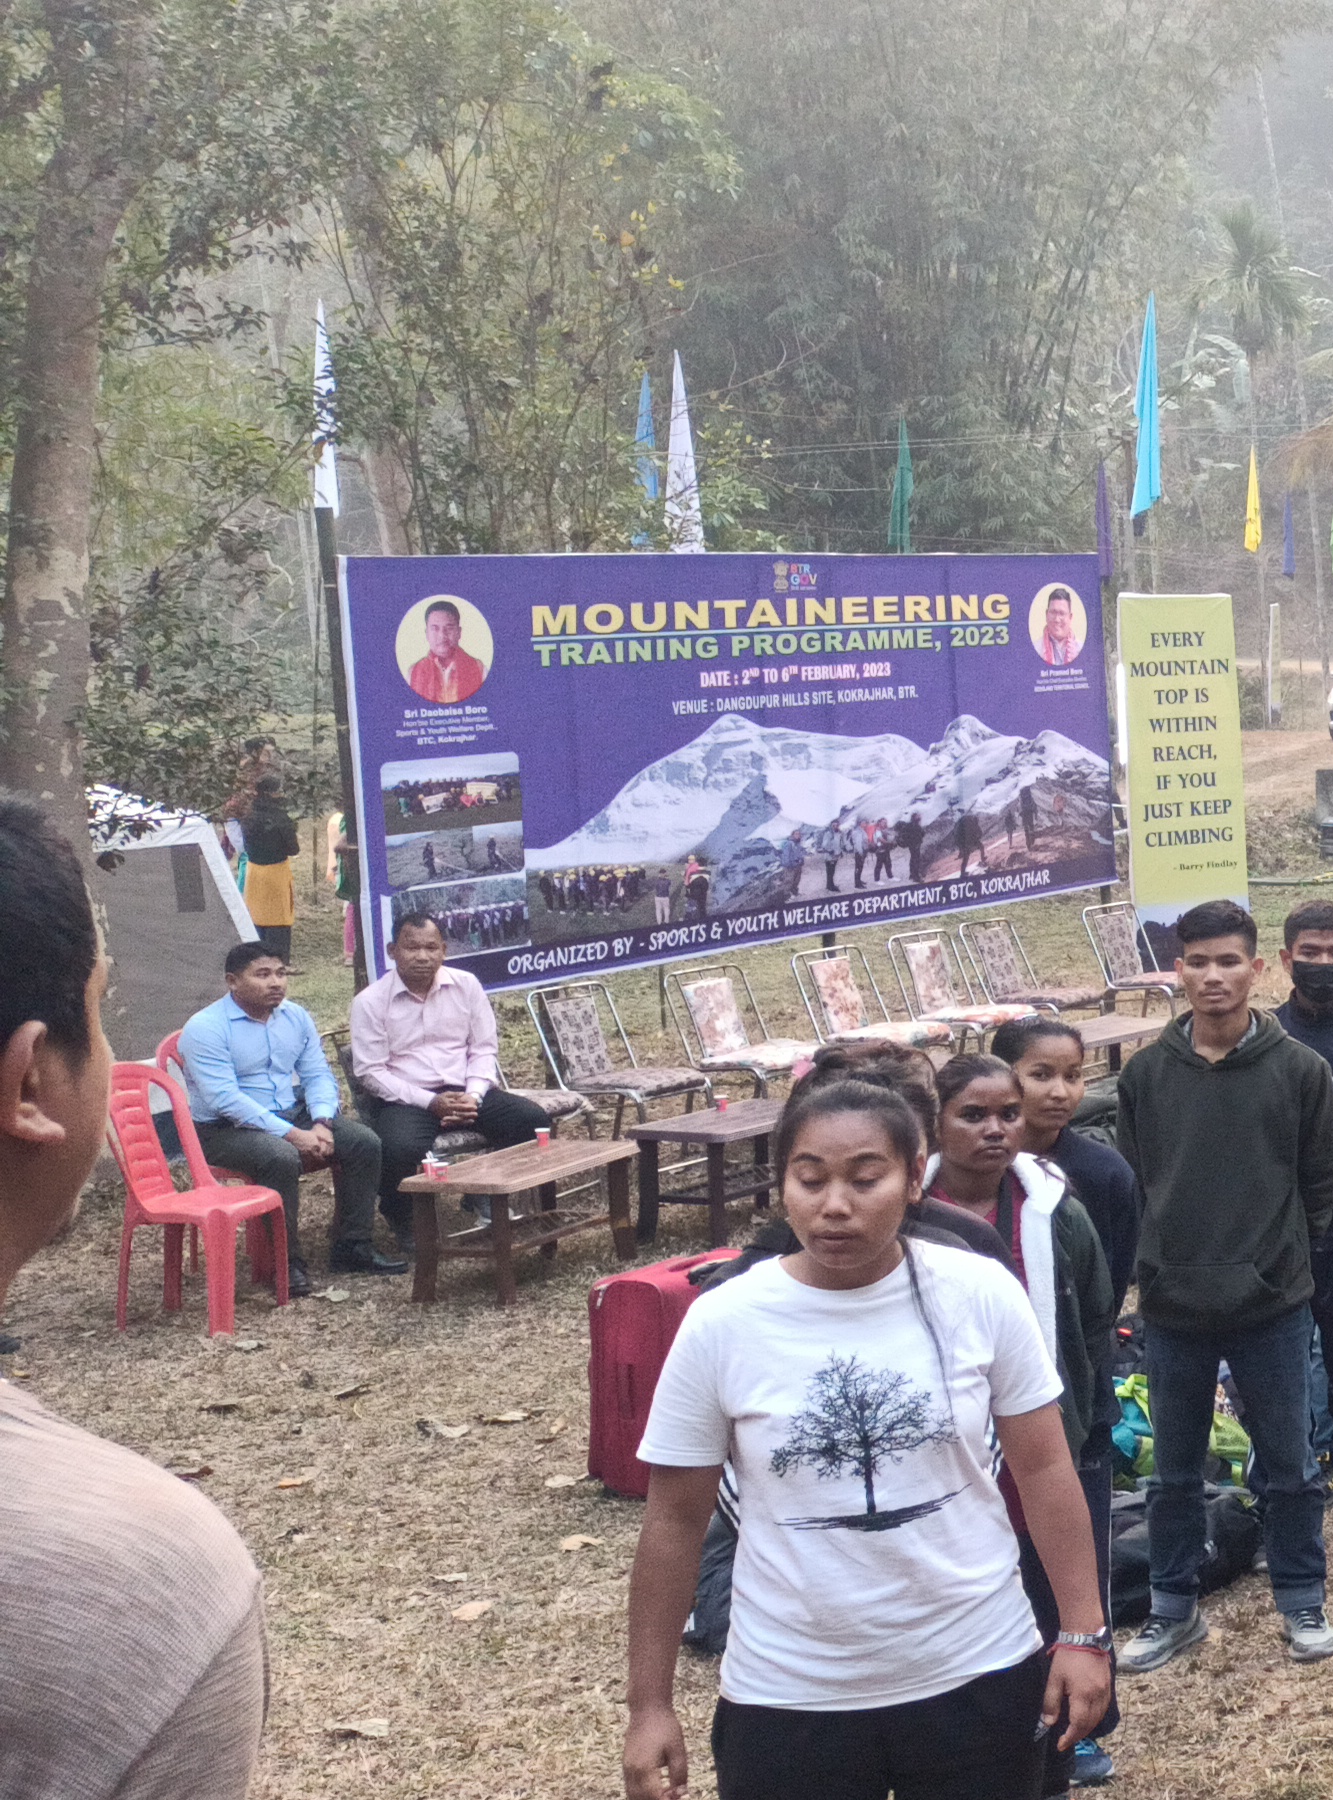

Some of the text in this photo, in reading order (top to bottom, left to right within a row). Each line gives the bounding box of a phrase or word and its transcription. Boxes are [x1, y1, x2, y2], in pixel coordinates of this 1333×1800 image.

[791, 574, 817, 586] GOV
[531, 593, 1010, 636] MOUNTAINEERING
[533, 625, 1009, 667] TRAINING PROGRAMME, 2023
[1151, 631, 1205, 648] EVERY
[700, 671, 731, 687] DATE
[742, 667, 759, 685] 2ND
[763, 668, 778, 683] TO
[781, 665, 798, 682] 6TH
[801, 663, 860, 682] FEBRUARY,
[863, 662, 891, 677] 2023
[1130, 658, 1229, 677] MOUNTAIN
[672, 700, 708, 715] VENUE
[717, 694, 781, 712] DANGDUPUR
[782, 693, 810, 707] HILLS
[812, 691, 836, 706] SITE,
[838, 687, 896, 703] KOKRAJHAR,
[898, 685, 918, 698] BTR.
[1154, 688, 1208, 705] TOP IS
[404, 710, 418, 718] Sri
[465, 706, 487, 714] Boro
[1149, 716, 1217, 733] WITHIN
[1153, 744, 1217, 762] REACH,
[1157, 772, 1216, 790] IF YOU
[1143, 799, 1232, 822] JUST KEEP
[1145, 827, 1233, 847] CLIMBING
[1179, 862, 1203, 872] Barry
[1207, 859, 1238, 869] Findlay
[508, 941, 608, 974] ORGANIZED
[612, 937, 633, 957] BY
[649, 924, 706, 950] SPORTS
[711, 922, 722, 940] &
[726, 912, 779, 936] YOUTH
[783, 902, 849, 926] WELFARE
[853, 887, 946, 916] DEPARTMENT,
[950, 882, 977, 902] BTC,
[980, 869, 1050, 895] KOKRAJHAR
